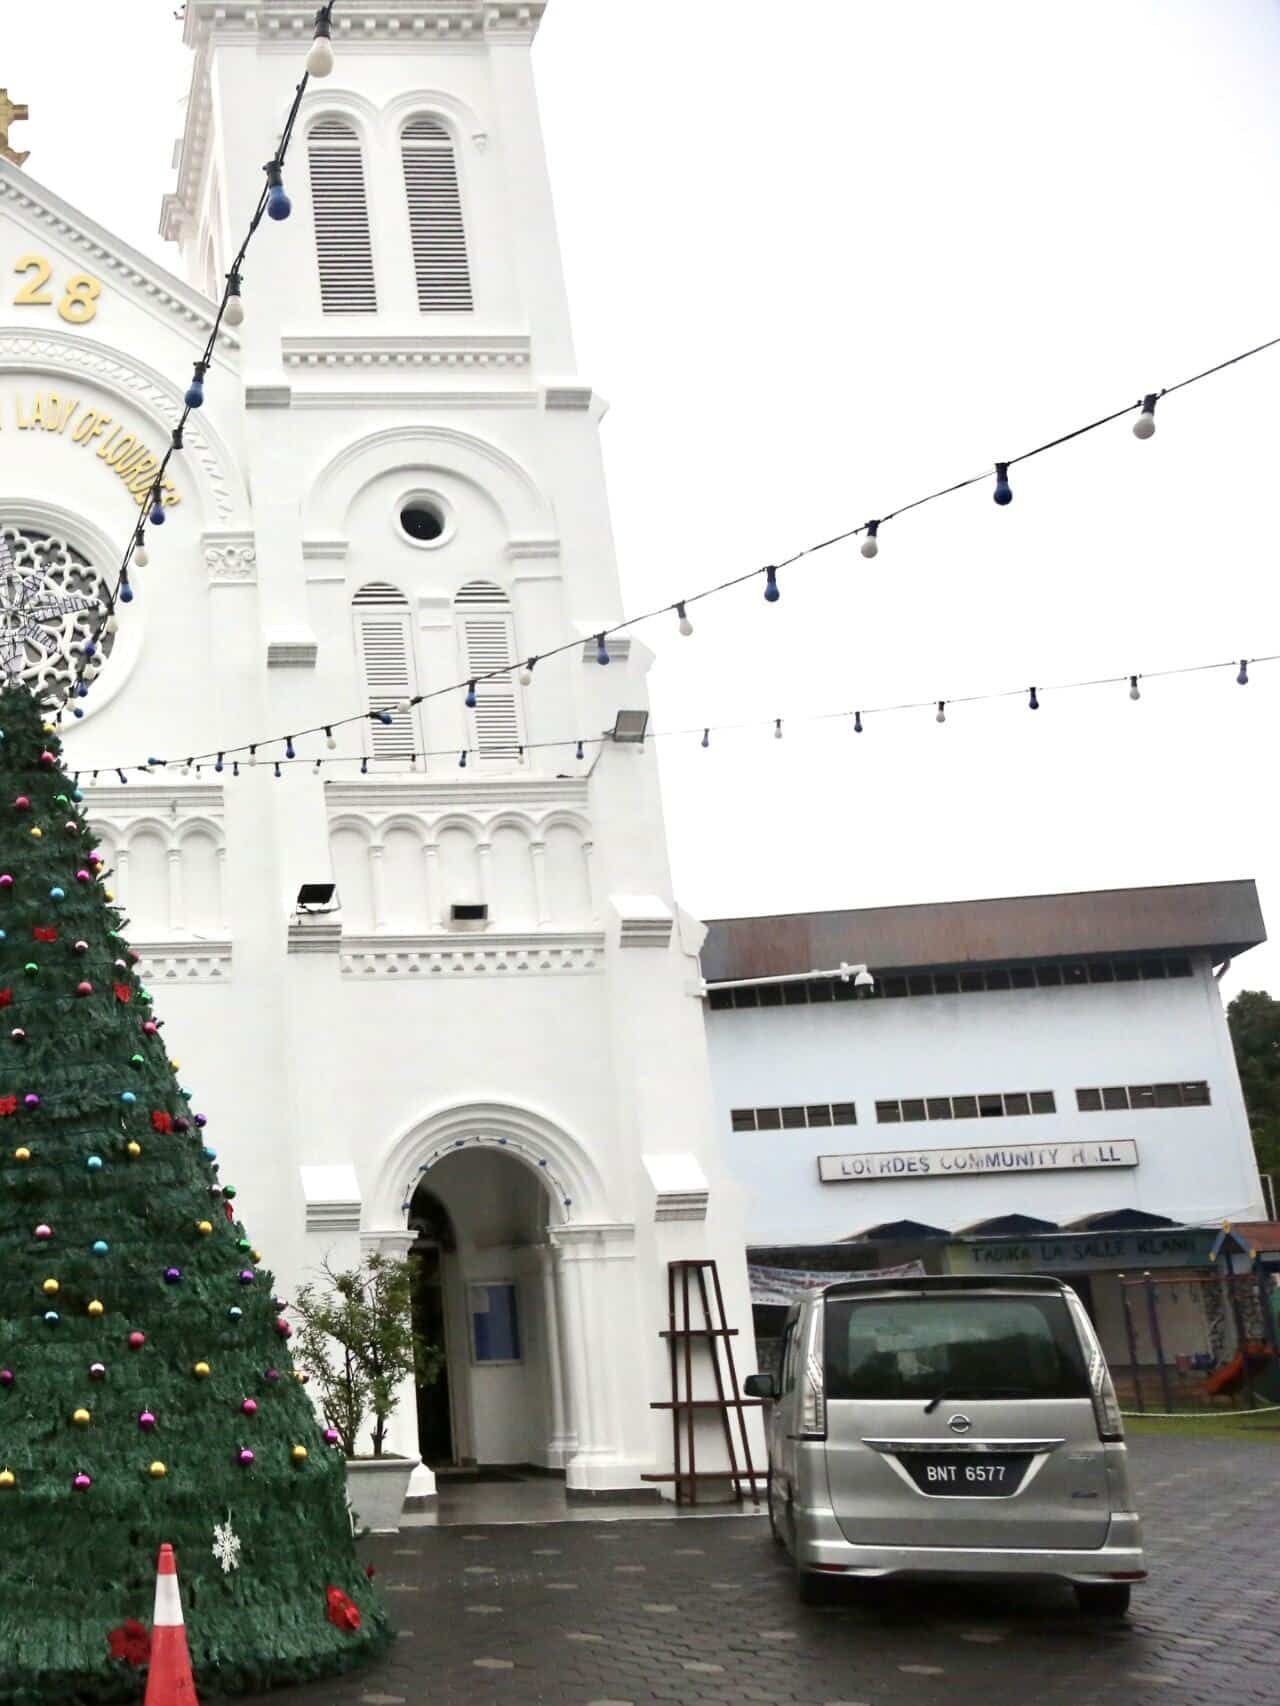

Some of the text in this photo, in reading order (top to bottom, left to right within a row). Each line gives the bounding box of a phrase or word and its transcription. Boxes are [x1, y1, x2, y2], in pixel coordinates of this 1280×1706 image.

[16, 392, 80, 434] LADY
[71, 407, 112, 447] OF
[1072, 1146, 1121, 1164] HLL
[926, 1466, 1006, 1481] BNT 6577
